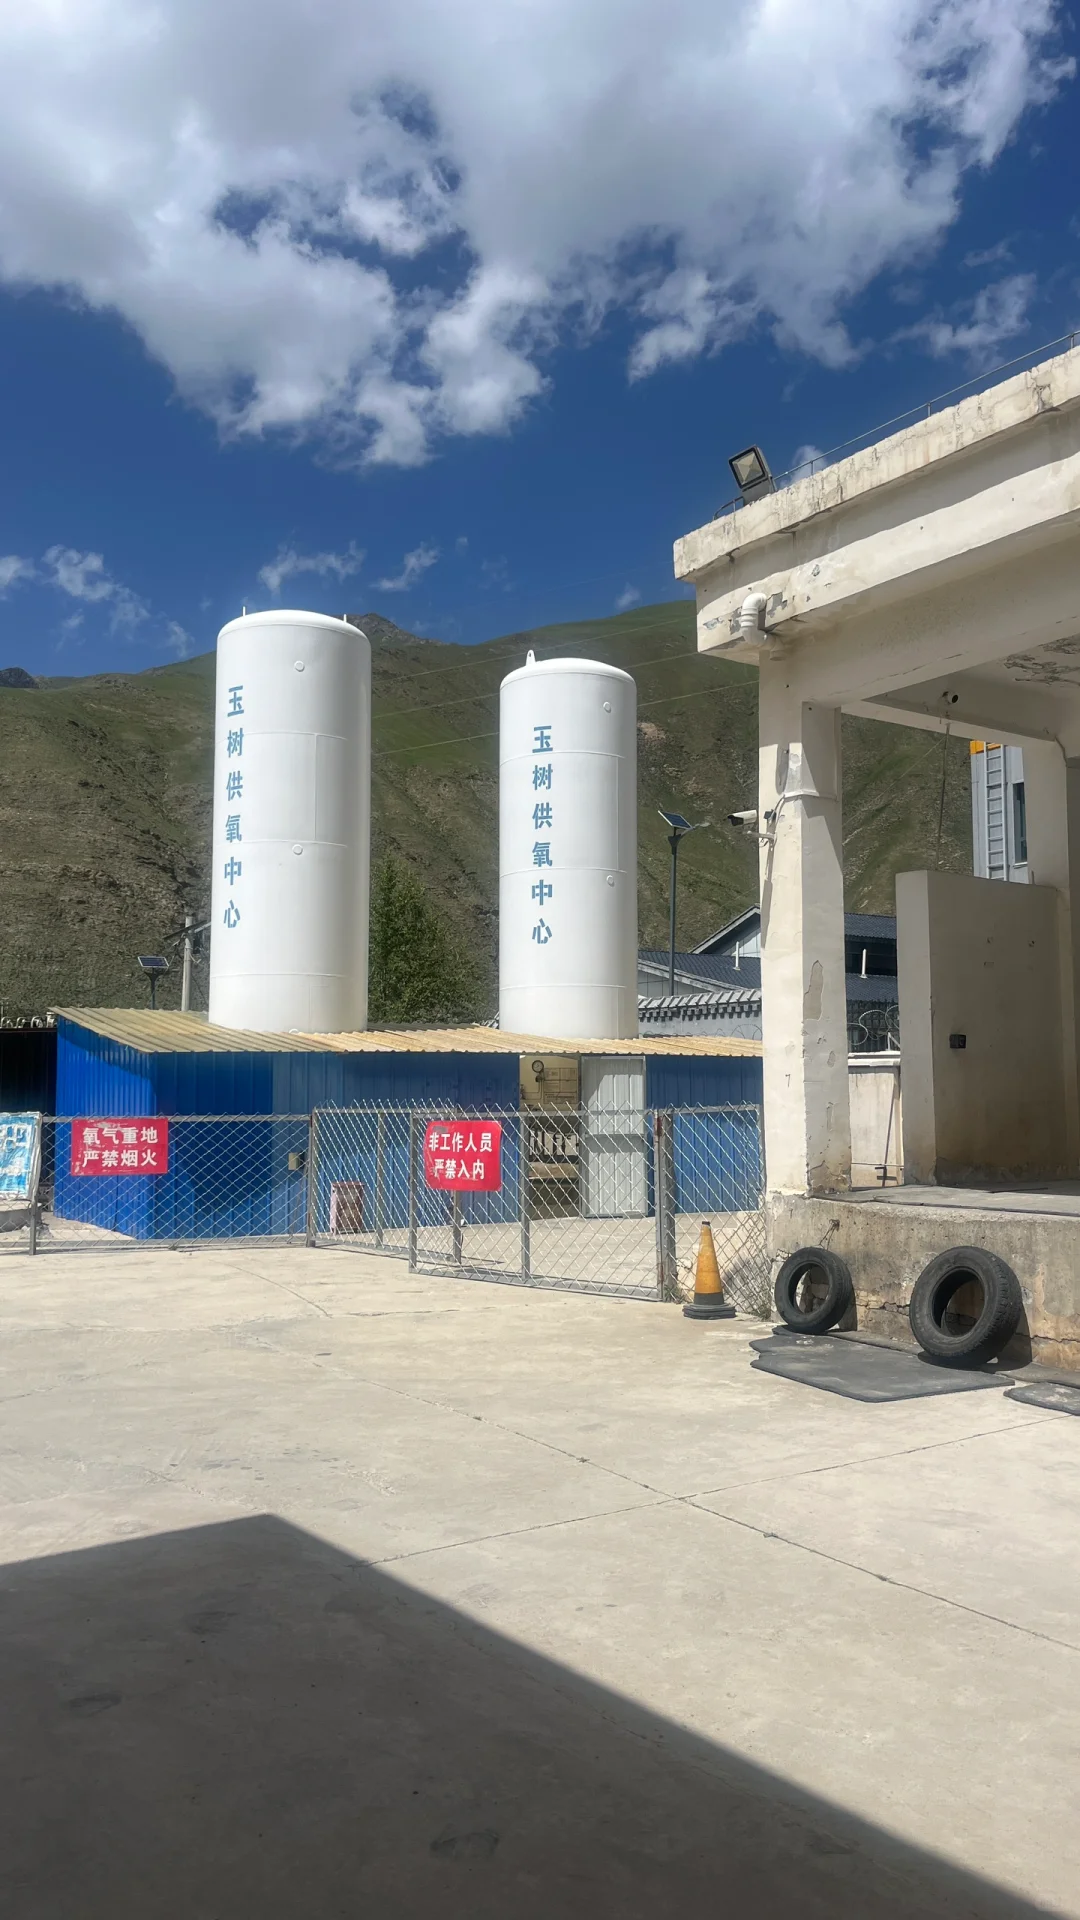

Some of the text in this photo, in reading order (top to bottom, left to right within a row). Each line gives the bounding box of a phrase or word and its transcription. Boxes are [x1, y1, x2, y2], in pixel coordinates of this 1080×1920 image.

[223, 685, 245, 929] 玉树供氧中心
[531, 725, 554, 944] 玉树供氧中心
[82, 1126, 159, 1144] 氧气重地
[428, 1132, 492, 1153] 非工作人员
[82, 1149, 158, 1168] 严禁烟火
[433, 1158, 485, 1180] 严禁入内
